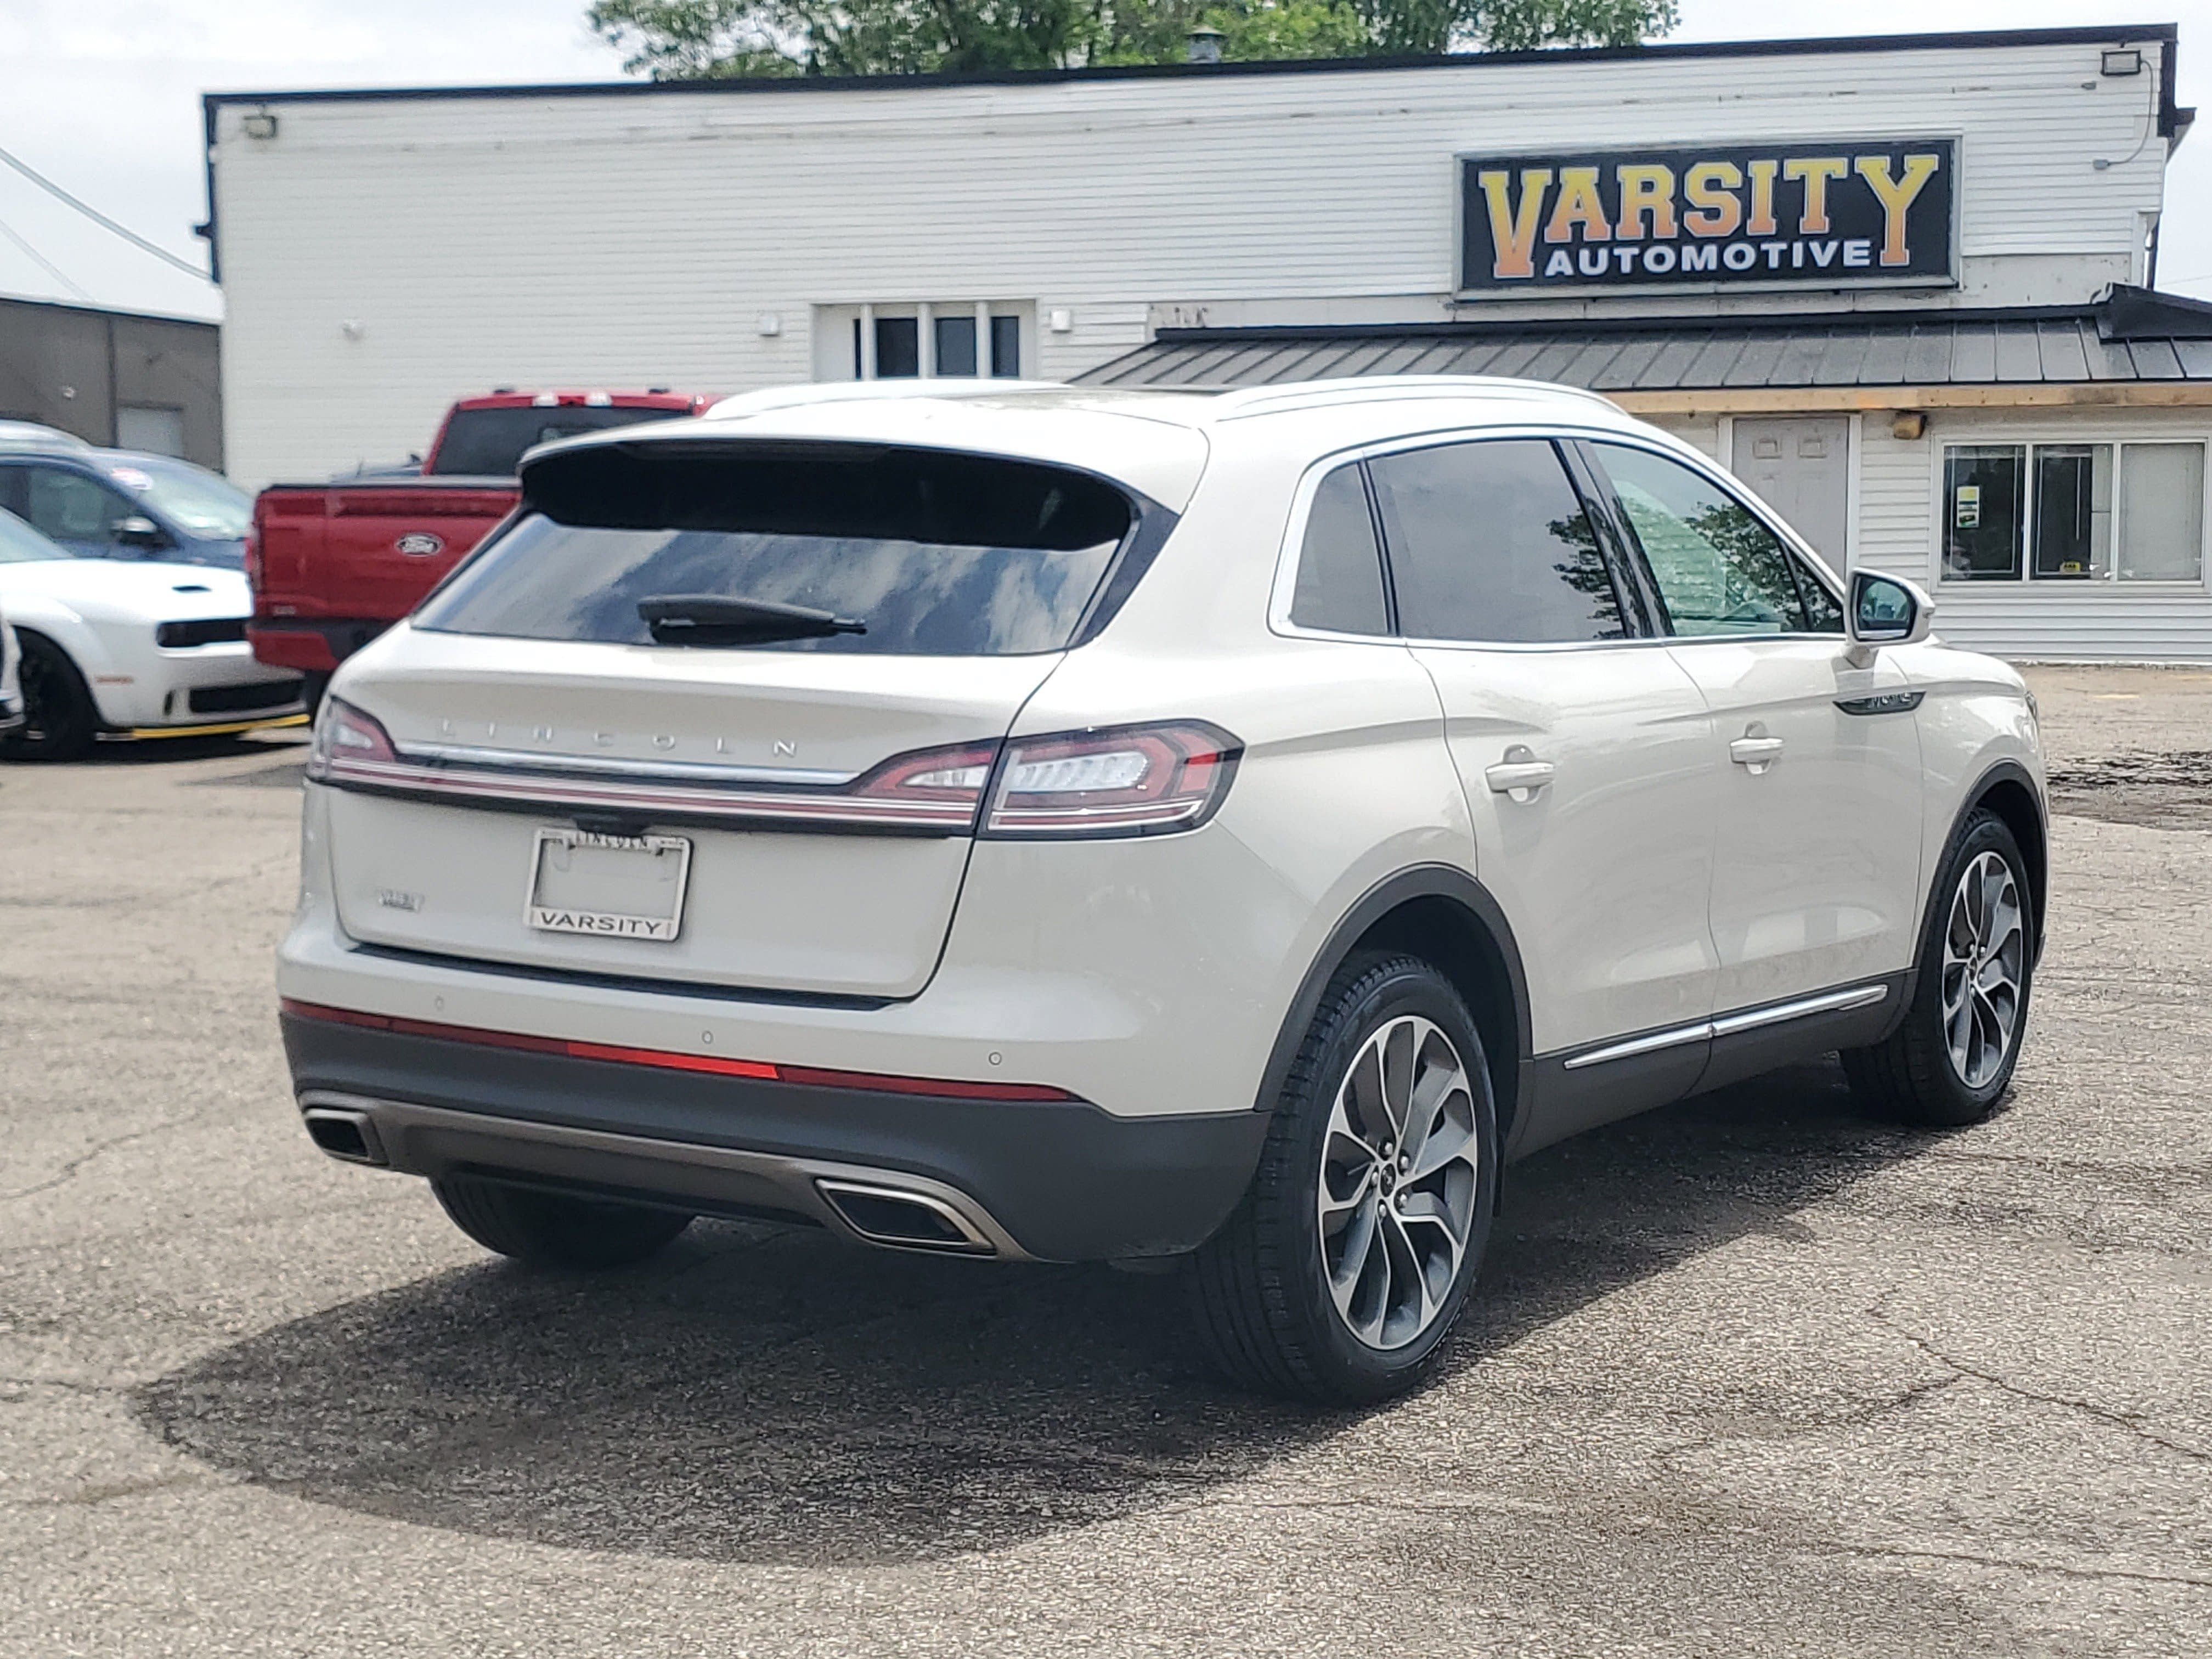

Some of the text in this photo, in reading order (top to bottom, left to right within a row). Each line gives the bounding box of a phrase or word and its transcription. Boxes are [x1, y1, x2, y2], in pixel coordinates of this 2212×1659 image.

[1479, 154, 1939, 278] VARSITY
[1544, 240, 1871, 276] AUTOMOTIVE
[441, 719, 797, 758] LINCOLN
[540, 911, 662, 934] VARSITY
